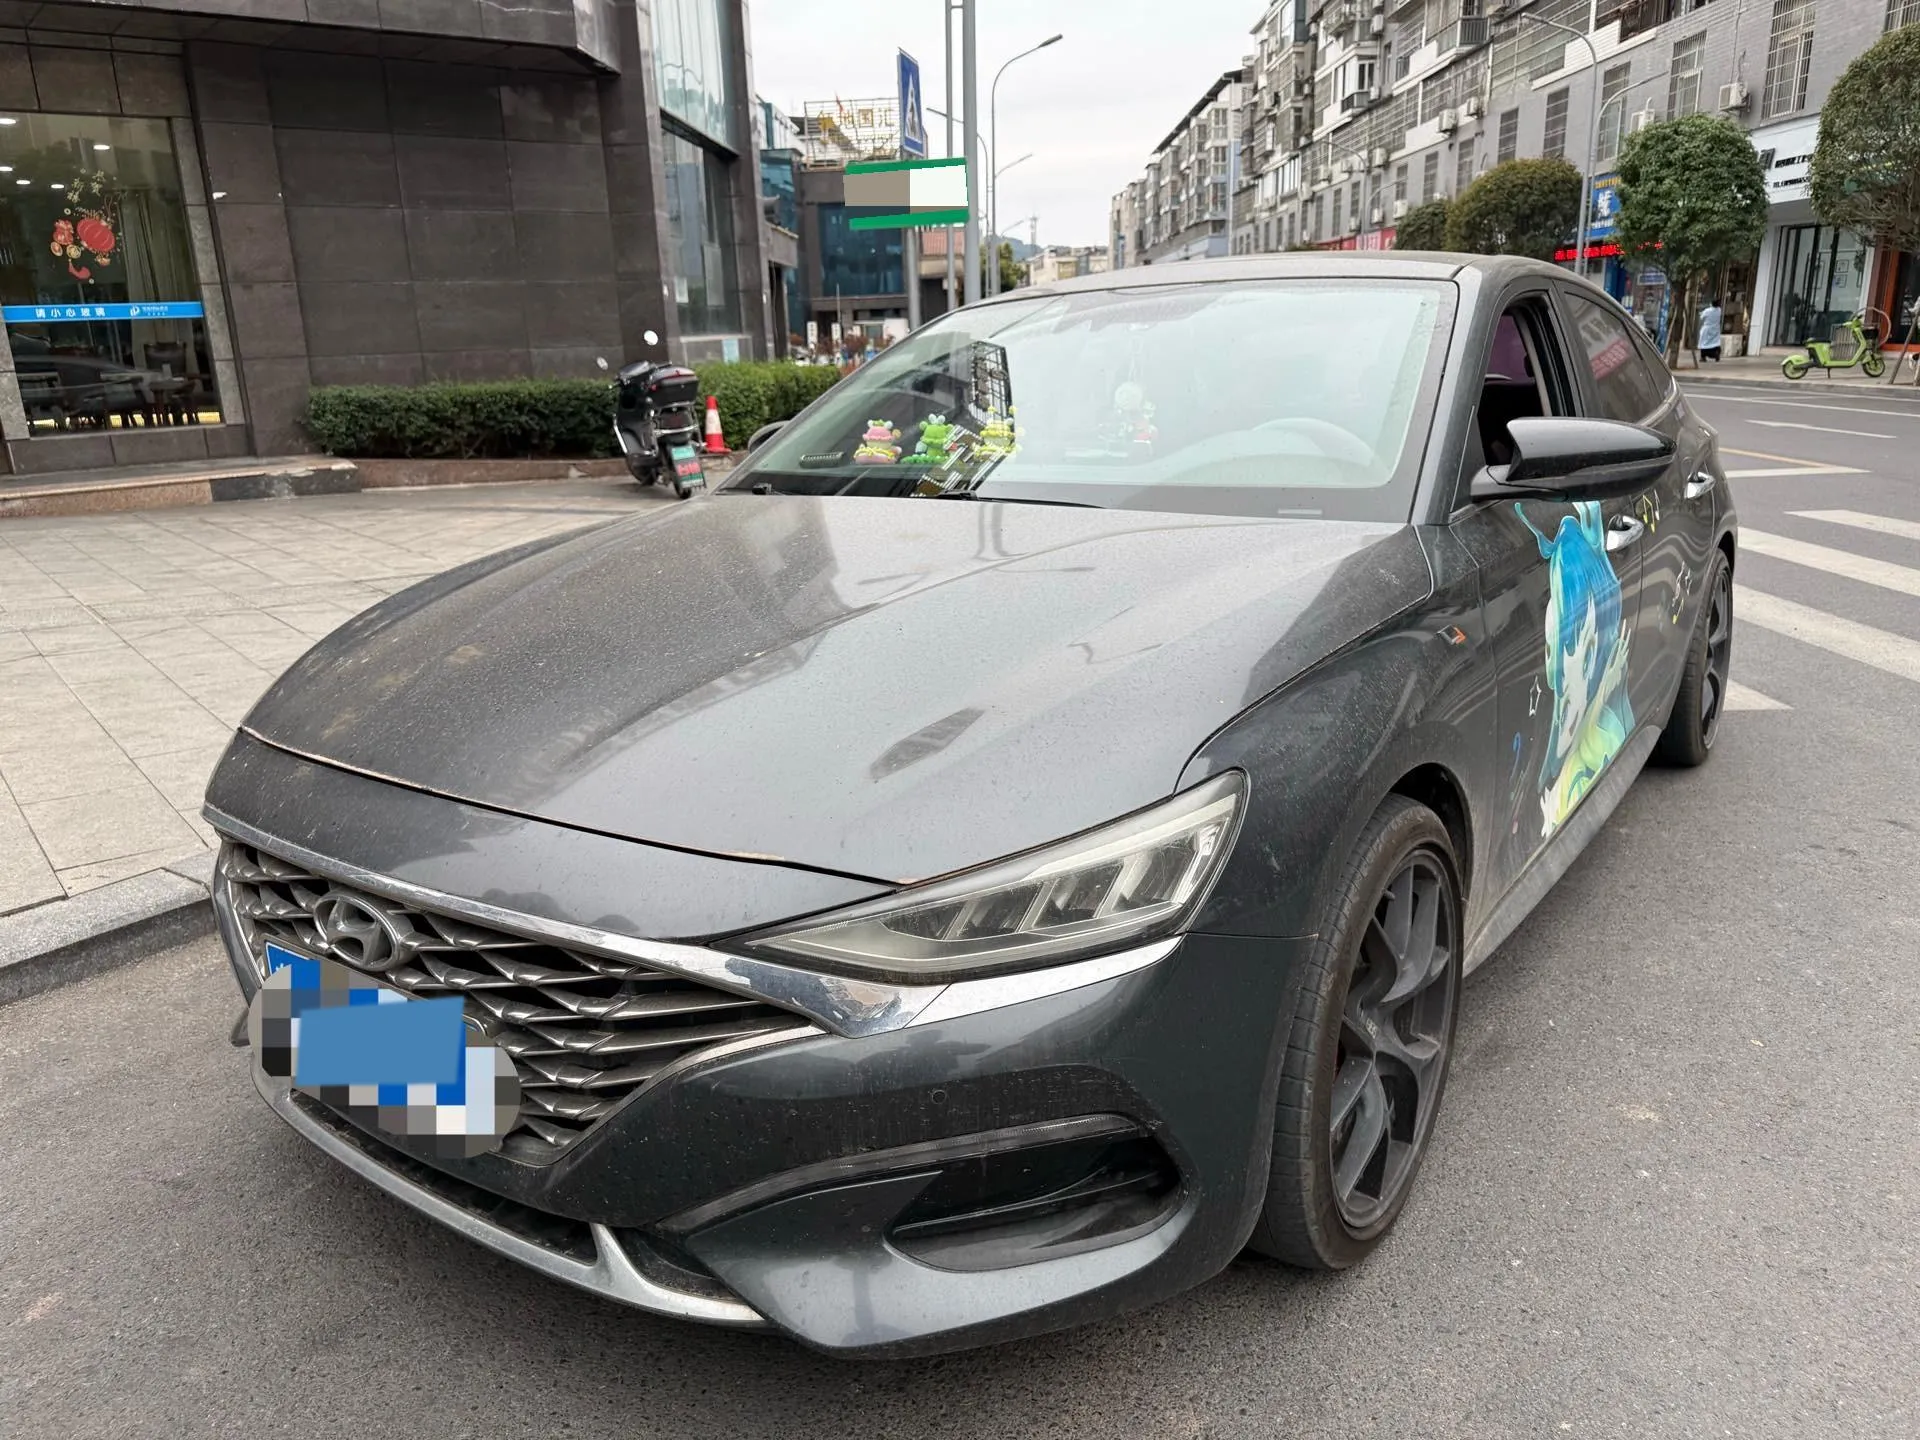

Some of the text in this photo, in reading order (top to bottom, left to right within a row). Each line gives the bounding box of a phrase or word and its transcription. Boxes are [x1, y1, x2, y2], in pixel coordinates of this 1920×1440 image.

[35, 307, 105, 318] 请小心玻璃
